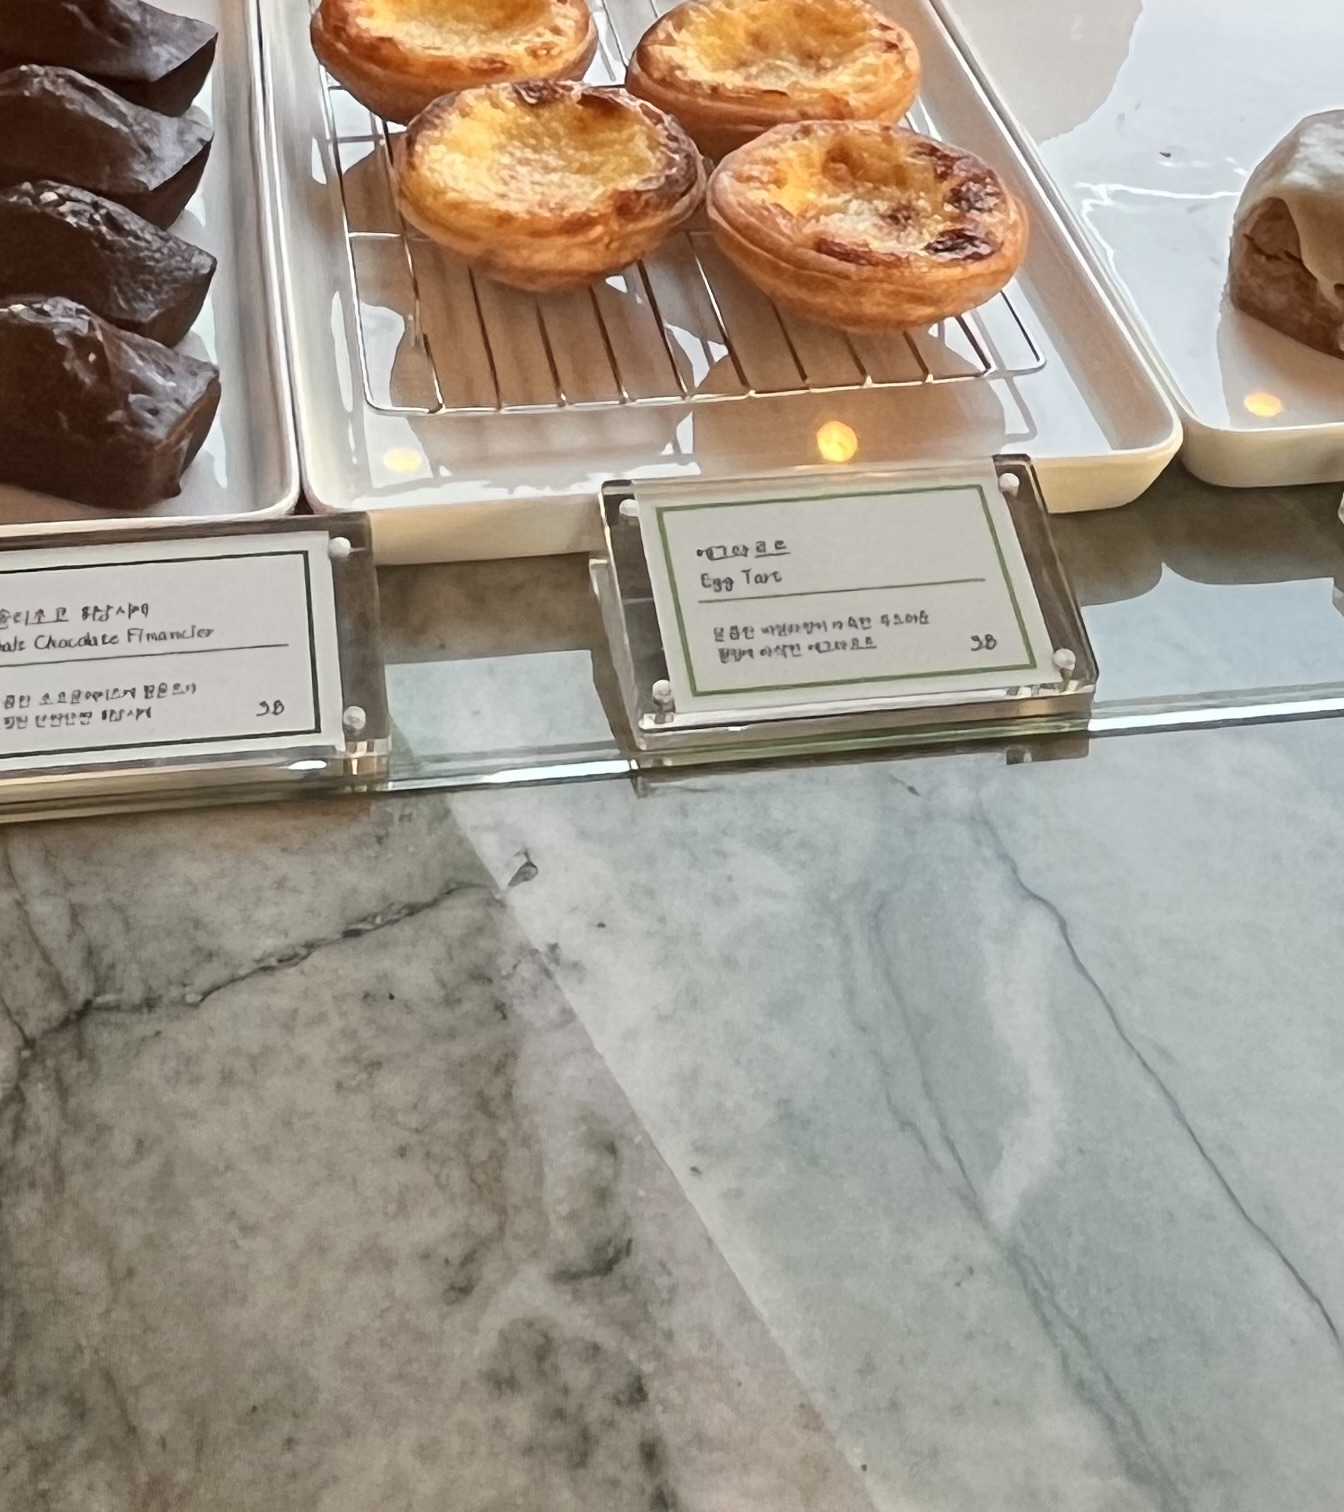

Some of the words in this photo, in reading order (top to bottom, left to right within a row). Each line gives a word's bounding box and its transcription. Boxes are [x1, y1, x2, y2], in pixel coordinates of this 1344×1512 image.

[696, 540, 791, 561] 에그타르트
[700, 573, 734, 593] Egg
[741, 568, 782, 584] Tart
[34, 632, 119, 651] Chocolate
[127, 624, 214, 644] Financier
